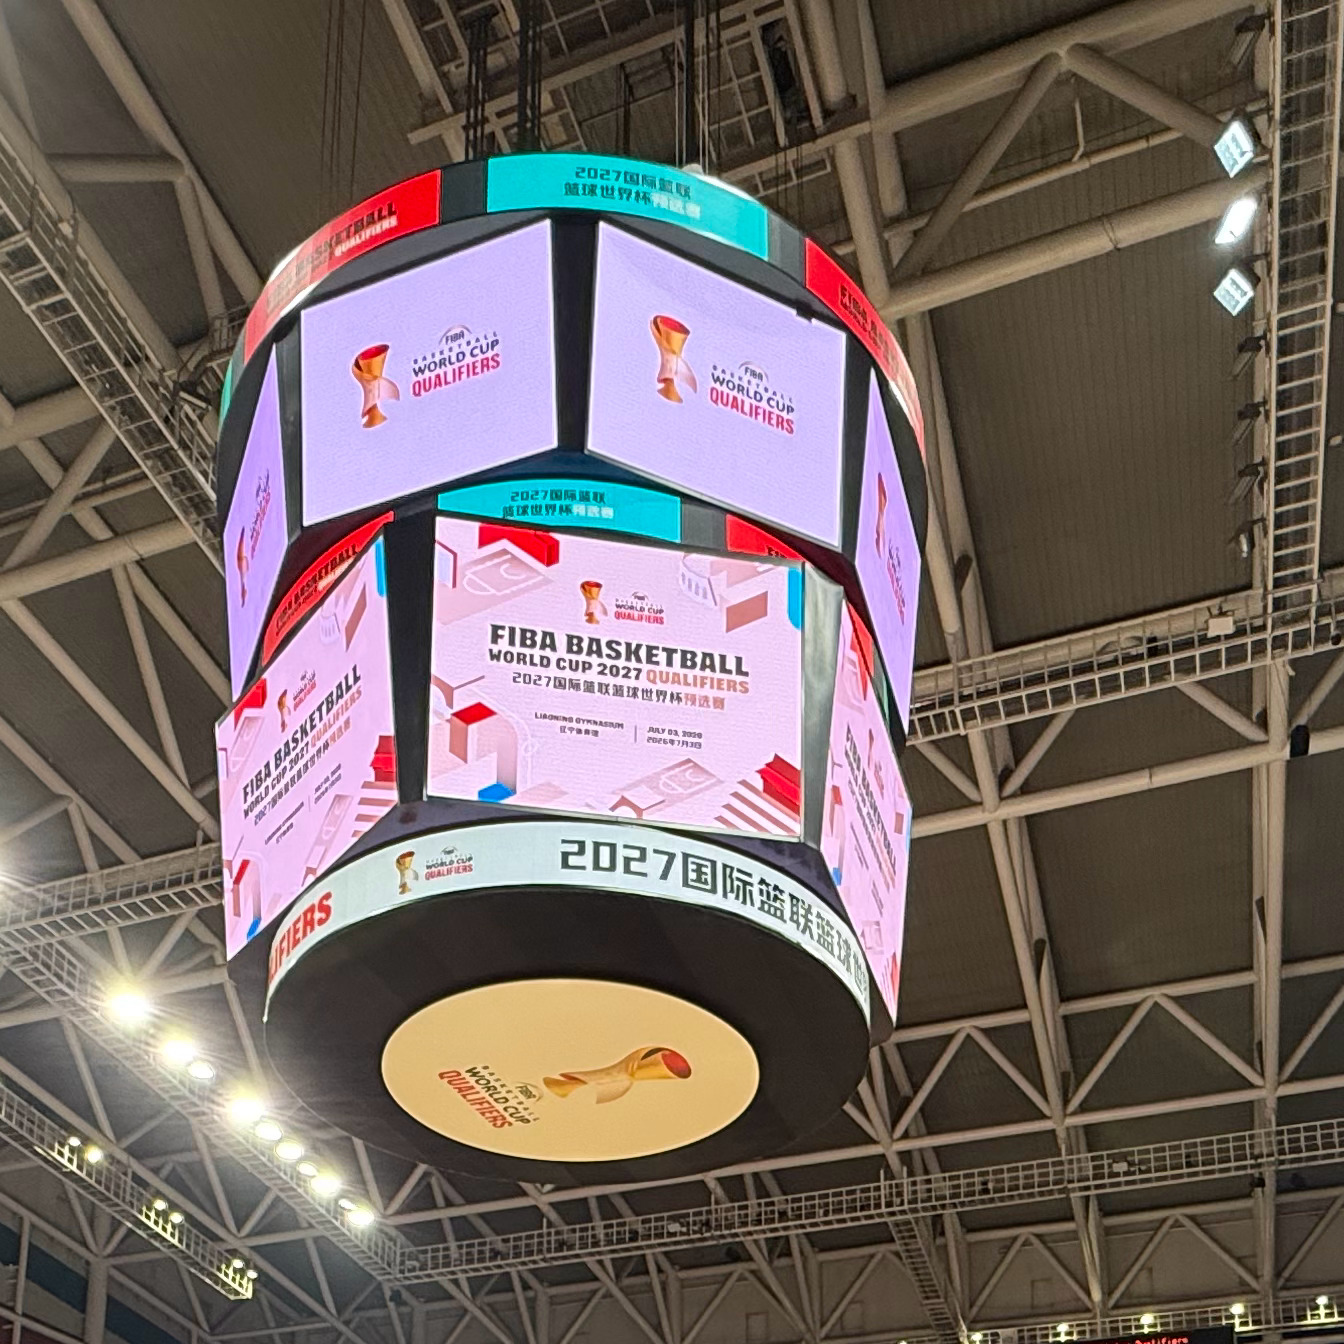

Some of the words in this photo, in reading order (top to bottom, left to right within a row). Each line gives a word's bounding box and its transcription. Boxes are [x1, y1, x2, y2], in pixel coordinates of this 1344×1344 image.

[412, 353, 500, 397] QUALIFIERS
[413, 351, 466, 377] WORLD
[470, 339, 499, 358] CUP
[710, 387, 794, 435] QUALIFIERS
[711, 372, 763, 403] WORLD
[767, 397, 794, 415] CUP
[614, 611, 665, 625] QUALIFIERS
[488, 648, 551, 669] WORLD
[556, 657, 593, 674] CUP
[597, 663, 643, 680] 2027
[646, 669, 749, 694] QUALIFIERS
[490, 624, 557, 652] FIBA
[566, 633, 749, 677] BASKETBALL
[242, 760, 271, 804] FIBA
[274, 664, 361, 772] BASKETBALL
[425, 864, 473, 880] QUALIFIERS
[438, 1070, 513, 1128] QUALIFIERS
[465, 1067, 509, 1104] WORLD
[503, 1106, 531, 1124] CUP
